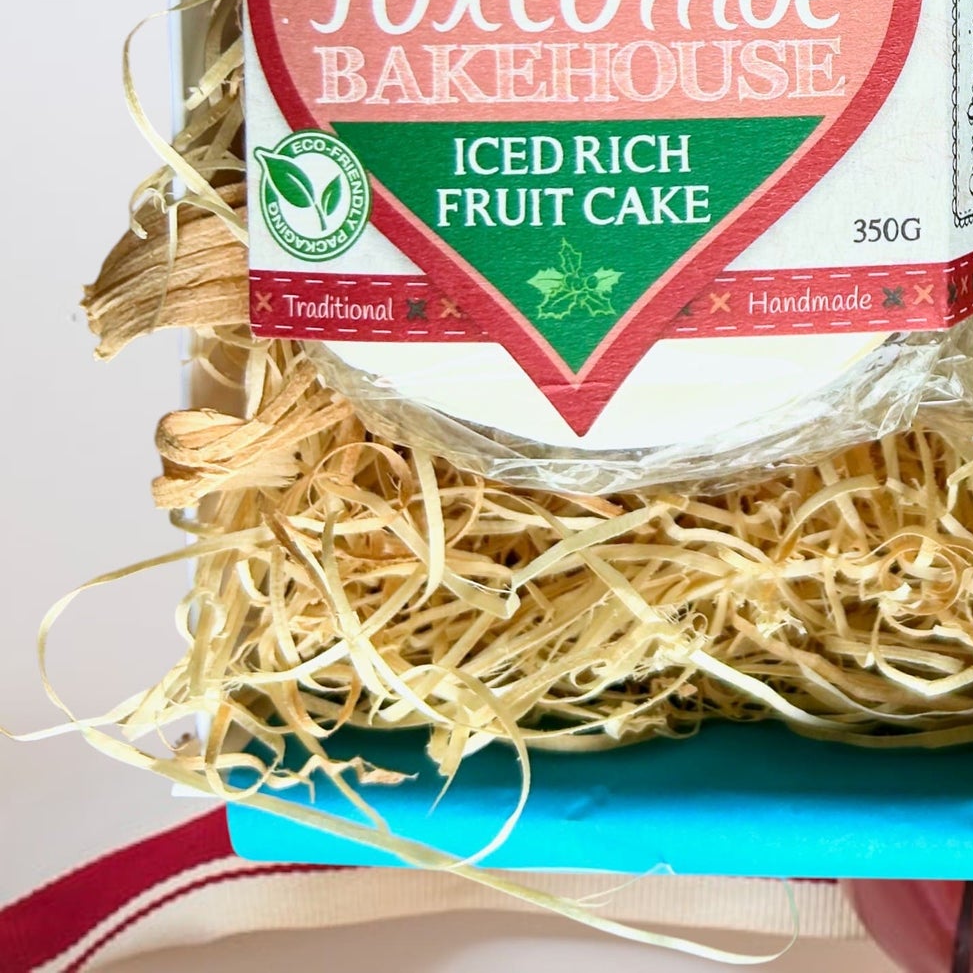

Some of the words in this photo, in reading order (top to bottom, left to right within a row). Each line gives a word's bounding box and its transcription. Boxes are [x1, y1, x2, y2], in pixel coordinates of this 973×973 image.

[313, 36, 847, 106] BAKEHOUSE
[453, 136, 564, 177] ICED
[573, 134, 692, 175] RICH
[291, 138, 366, 232] ECO-FRIENDLY
[436, 187, 576, 228] FRUIT
[582, 185, 712, 226] CAKE
[267, 201, 349, 254] PACKAGING
[852, 217, 922, 244] 350G
[281, 293, 394, 322] Traditional
[747, 288, 873, 315] Handmade
